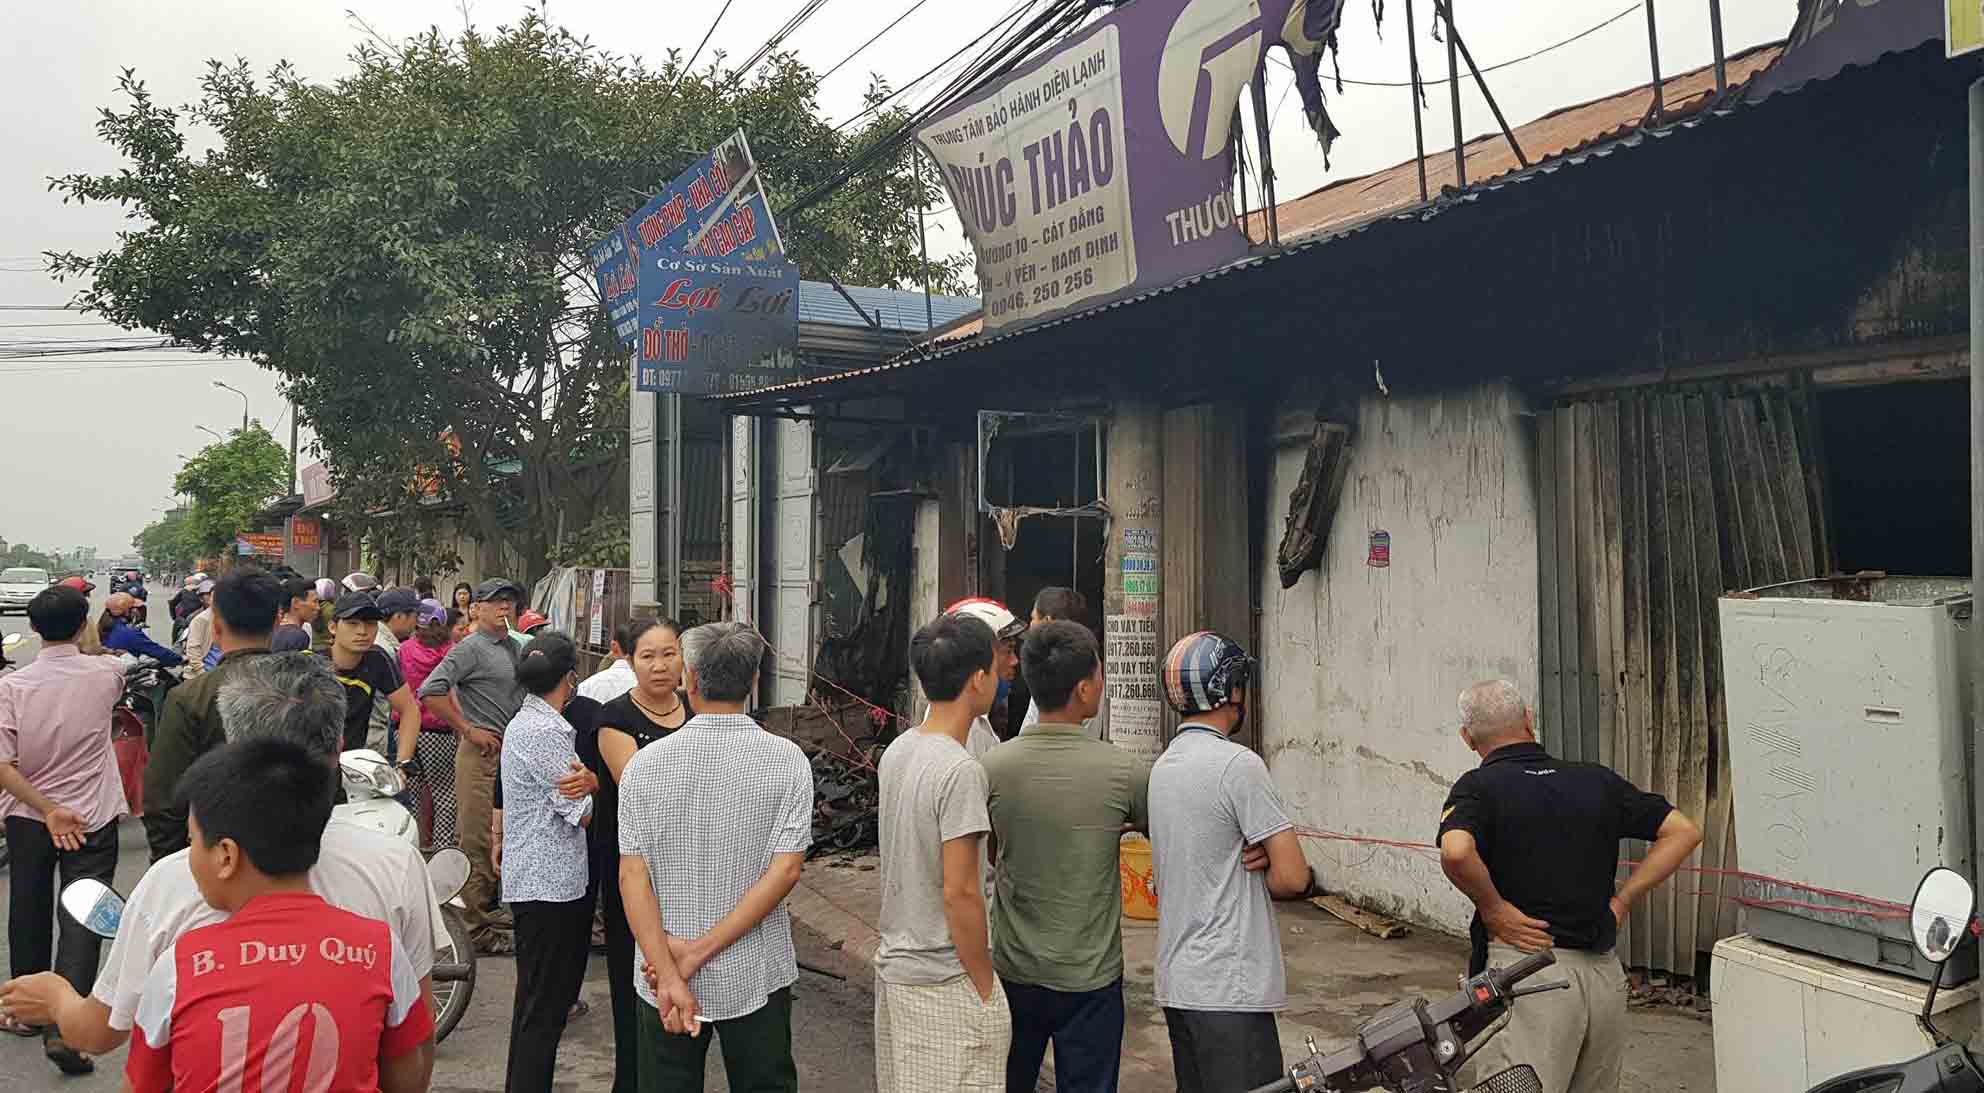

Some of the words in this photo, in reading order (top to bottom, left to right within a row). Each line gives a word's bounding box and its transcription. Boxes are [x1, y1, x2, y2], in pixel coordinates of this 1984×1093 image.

[931, 129, 963, 146] TRUNG
[963, 116, 986, 141] TÂM
[1009, 87, 1041, 120] HÀNH
[1072, 49, 1106, 88] LẠNH
[1023, 97, 1114, 216] THẢO
[1042, 220, 1066, 245] CÁT
[657, 258, 680, 271] Cơ
[1015, 263, 1037, 284] YÊN
[1051, 246, 1081, 273] NAM
[1033, 280, 1060, 305] 250
[1064, 267, 1094, 295] 256
[642, 316, 662, 361] ĐỒ
[664, 320, 689, 361] THỜ
[1121, 619, 1136, 633] VAY
[1121, 661, 1136, 675] VAY
[192, 950, 224, 977] B.
[240, 940, 306, 967] Duy
[319, 937, 377, 970] Quý
[216, 1002, 341, 1093] 10
